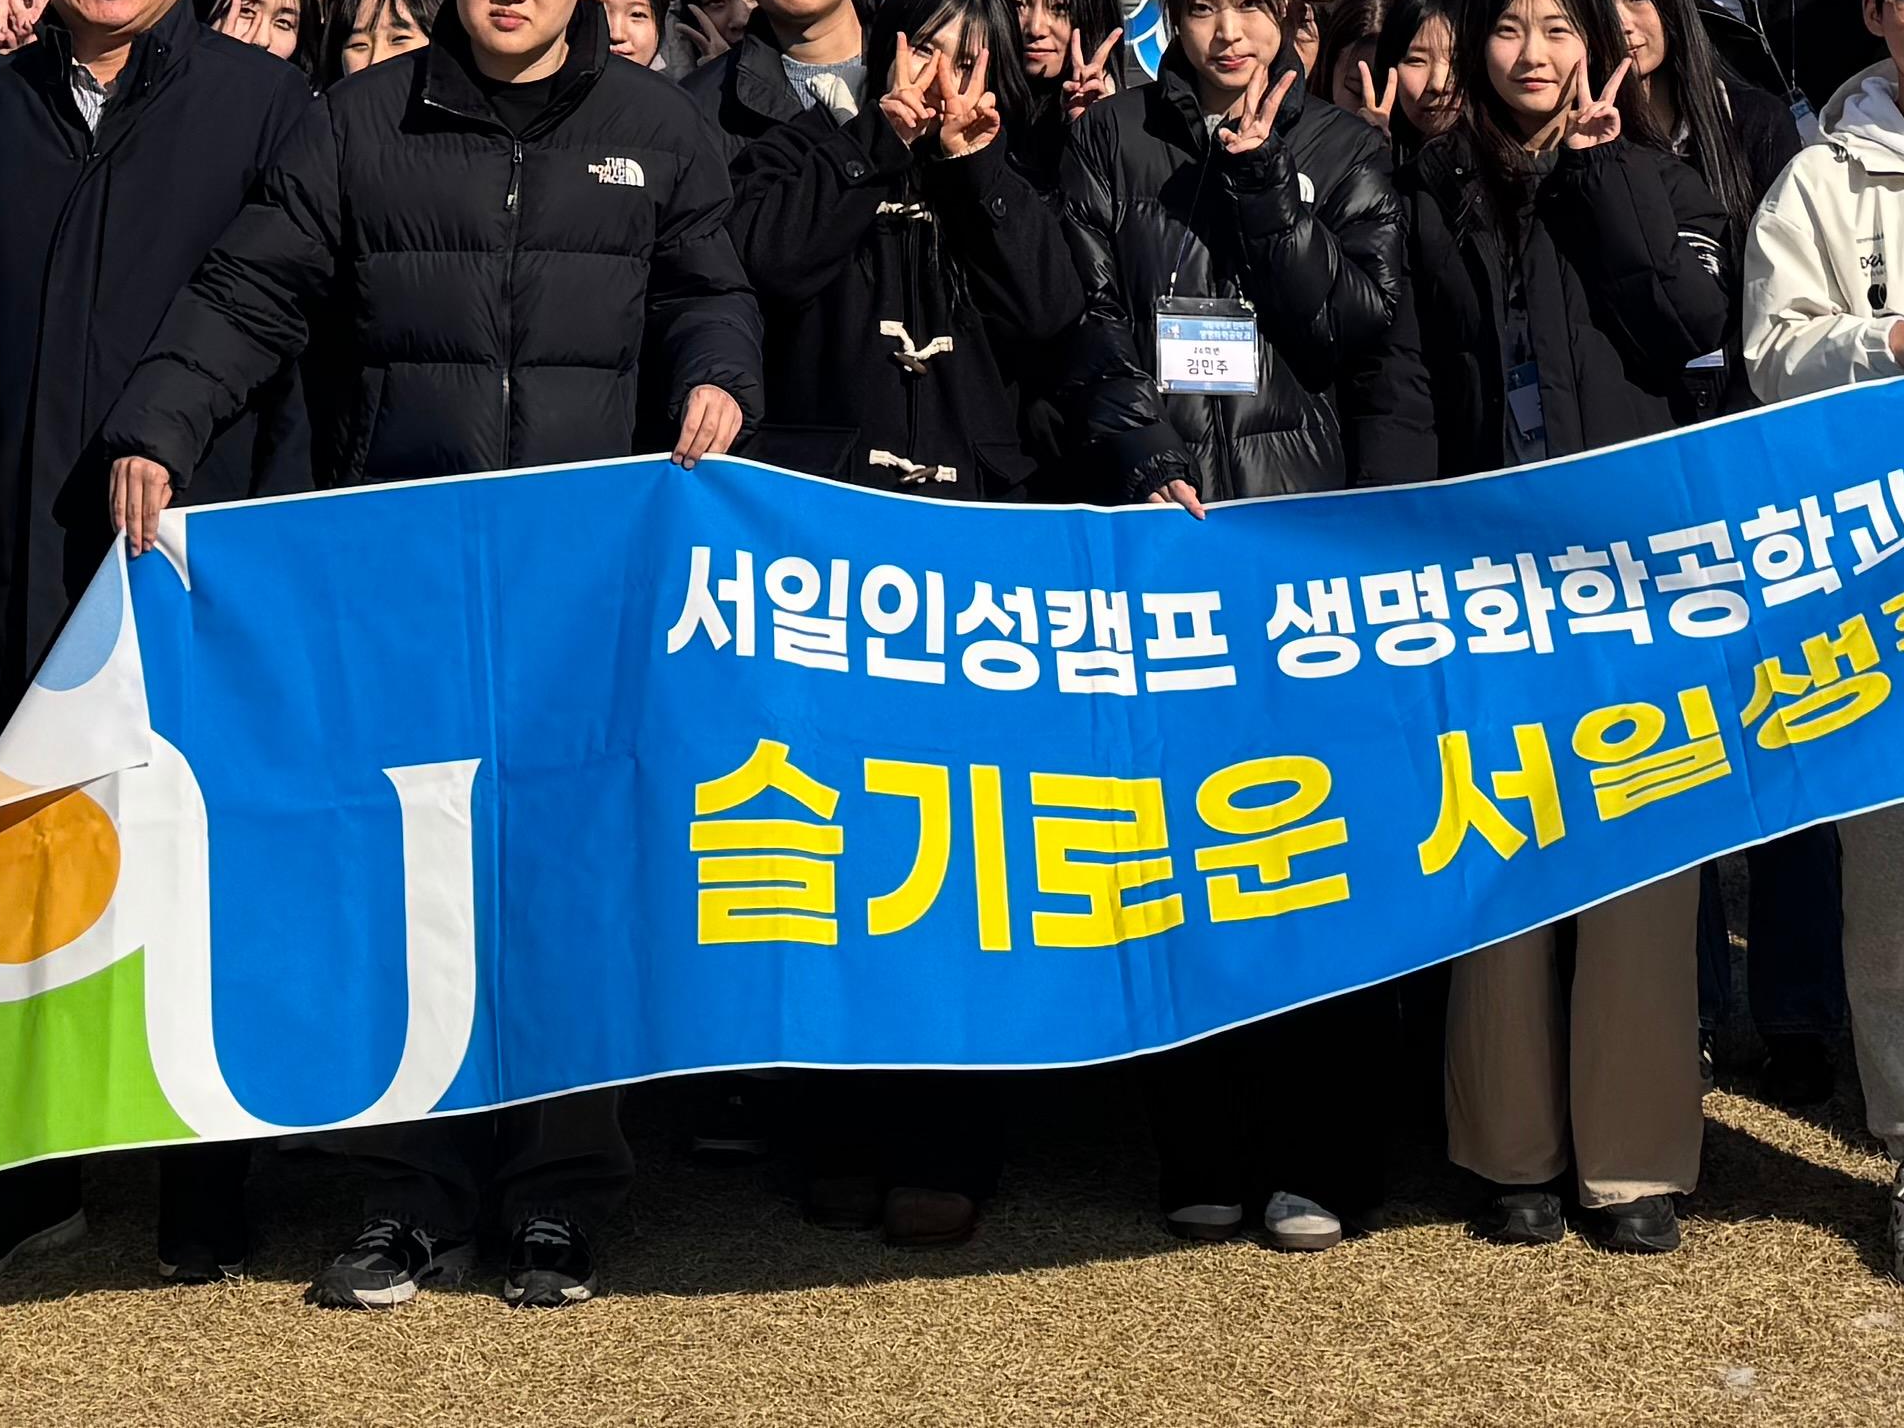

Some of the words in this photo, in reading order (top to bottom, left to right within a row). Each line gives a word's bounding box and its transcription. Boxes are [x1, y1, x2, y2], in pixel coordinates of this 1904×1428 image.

[1186, 358, 1229, 375] 김민주
[666, 545, 1238, 697] 서일인성캠프
[689, 737, 1351, 952] 슬기로운
